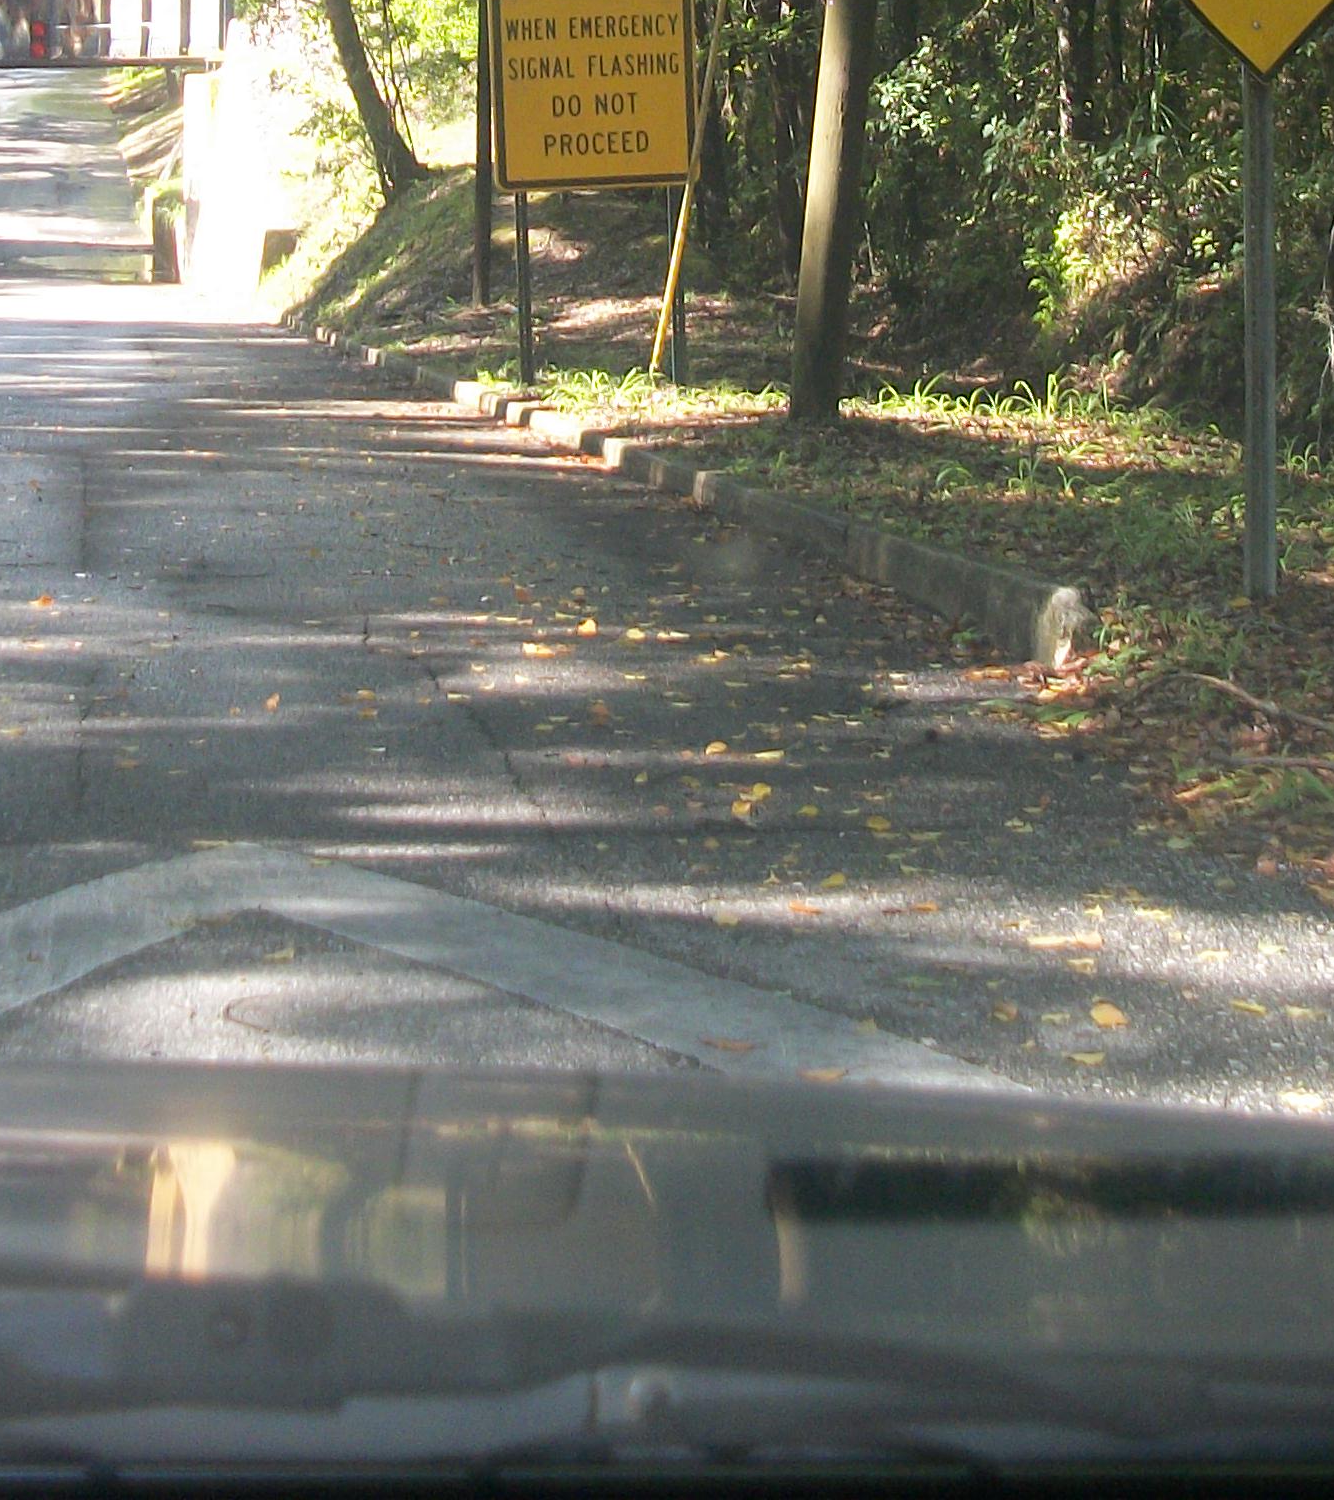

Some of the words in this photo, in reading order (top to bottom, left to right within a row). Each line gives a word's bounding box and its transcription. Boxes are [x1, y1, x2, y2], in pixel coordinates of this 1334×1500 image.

[505, 17, 557, 42] WHEN
[569, 13, 679, 40] EMERGENCY
[507, 56, 575, 81] SIGNAL
[587, 52, 680, 78] FLASHING
[551, 94, 582, 118] DO
[594, 91, 637, 116] NOT
[543, 130, 649, 157] PROCEED
